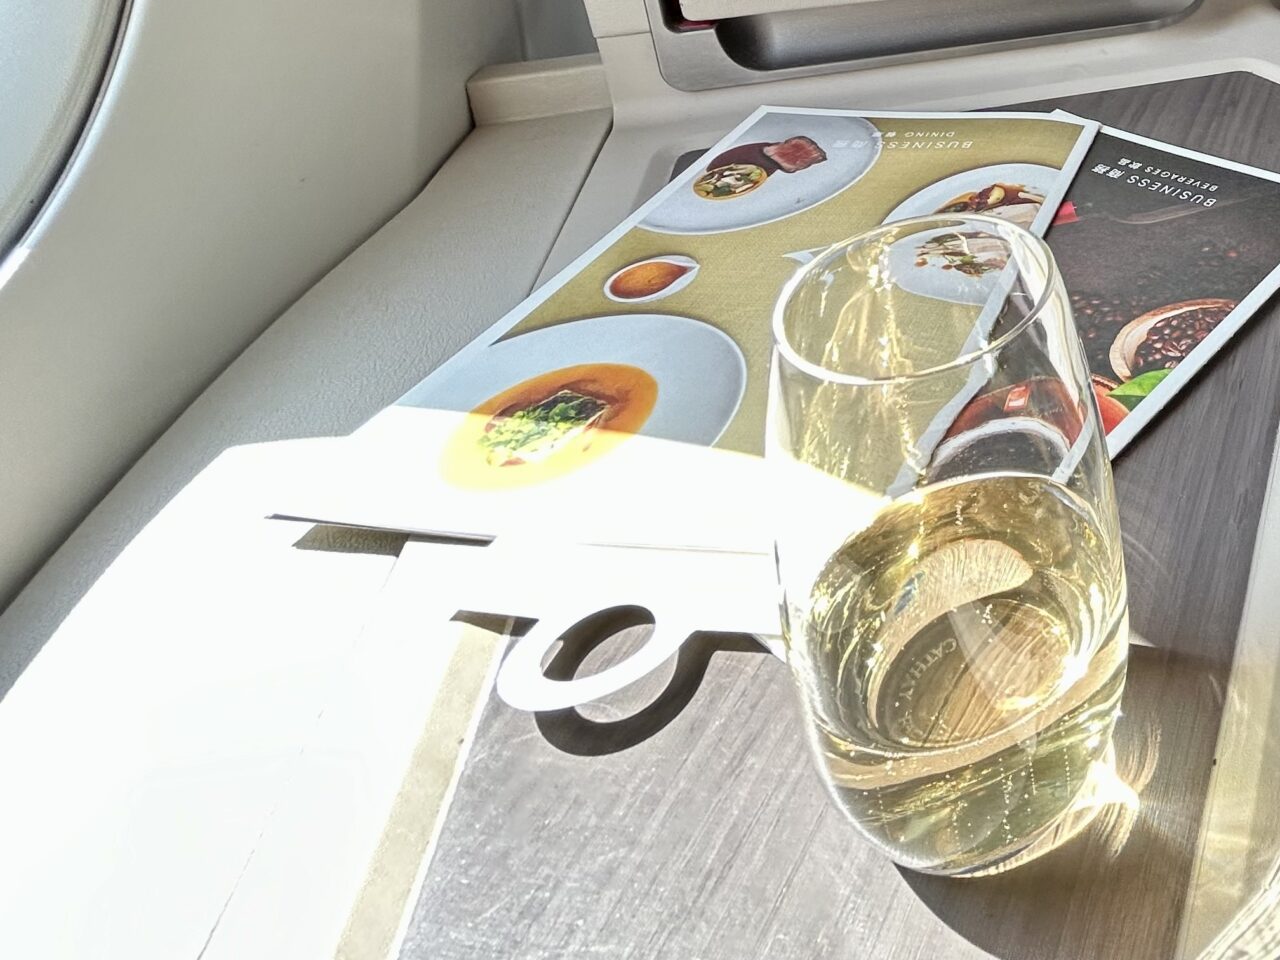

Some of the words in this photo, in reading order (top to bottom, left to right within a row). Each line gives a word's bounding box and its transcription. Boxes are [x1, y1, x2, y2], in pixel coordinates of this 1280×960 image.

[874, 141, 974, 149] BUSINESS
[1091, 163, 1125, 179] 商務
[1144, 166, 1219, 192] BEVERAGES
[1126, 175, 1217, 207] BUSINESS
[899, 638, 957, 701] CATHAY
